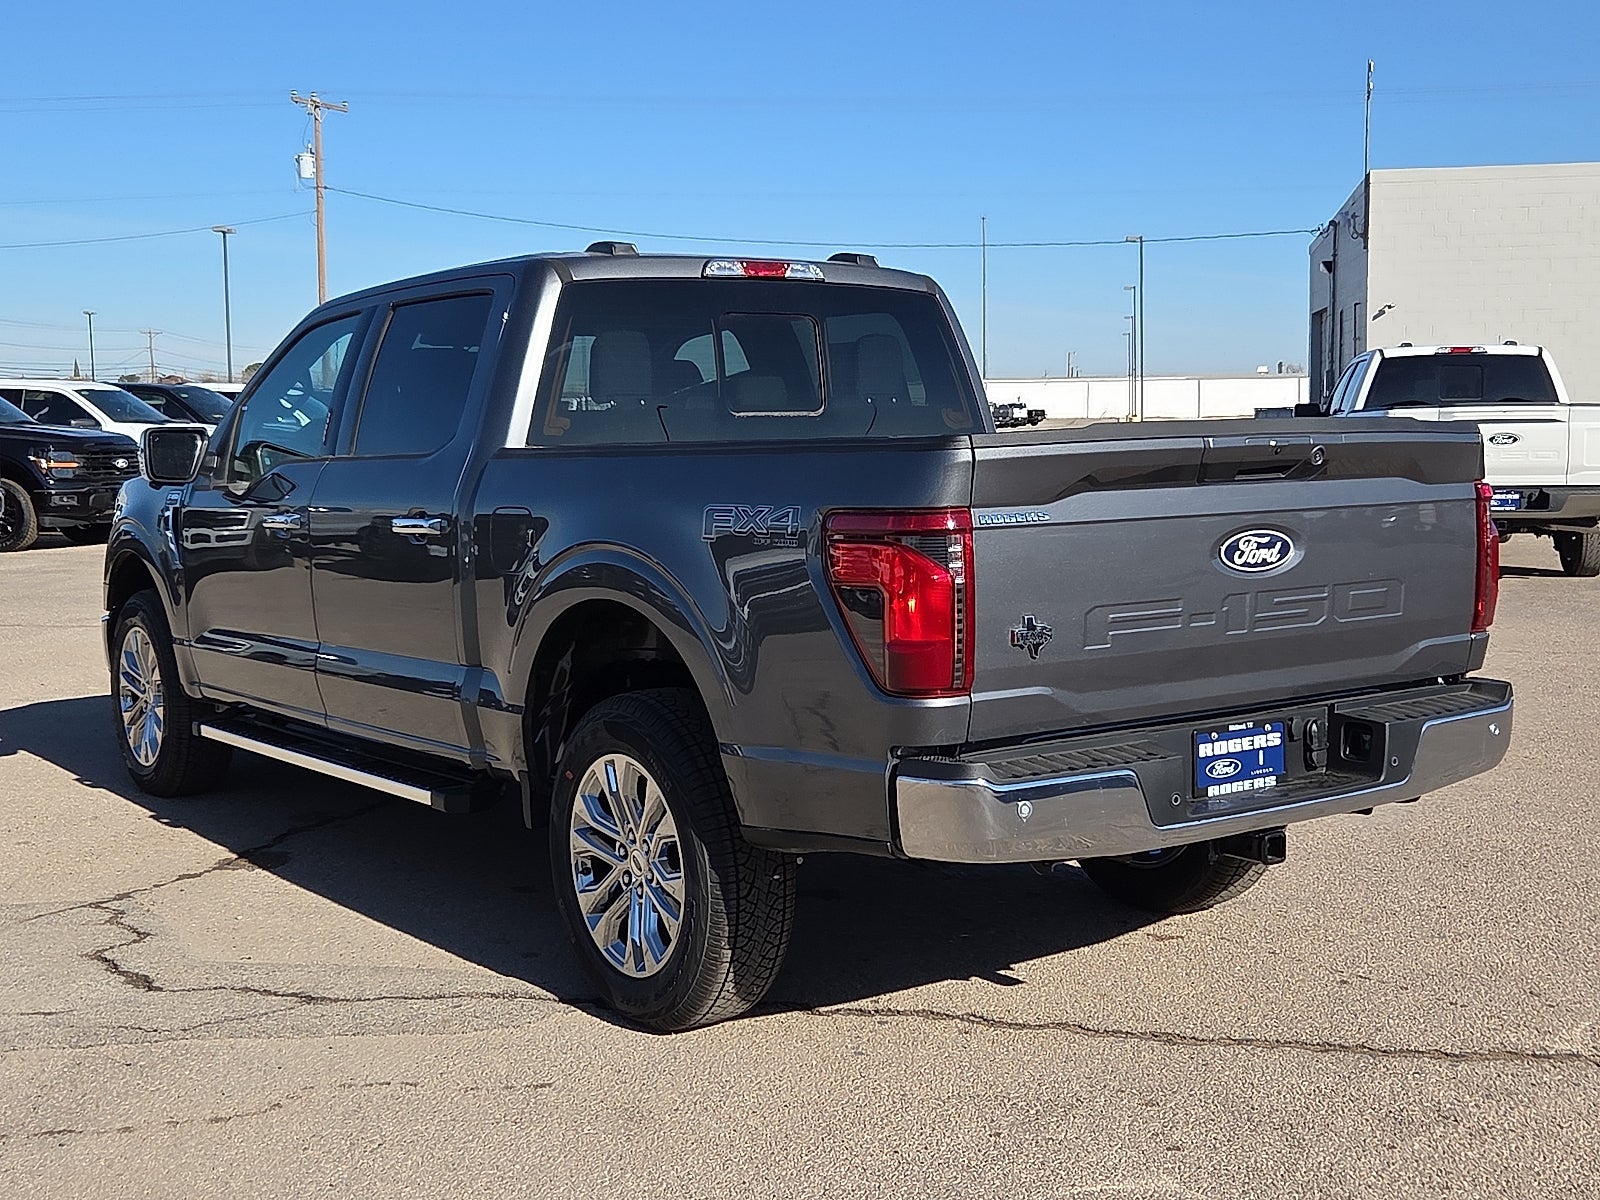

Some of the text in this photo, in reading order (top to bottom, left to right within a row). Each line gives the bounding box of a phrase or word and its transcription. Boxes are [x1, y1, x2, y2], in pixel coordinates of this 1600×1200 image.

[701, 504, 800, 541] FX4
[978, 511, 1050, 525] ROGERS
[1234, 536, 1283, 565] Ford
[1083, 578, 1404, 650] F-150
[1198, 732, 1282, 758] ROGERS
[1207, 775, 1277, 798] ROGERS
